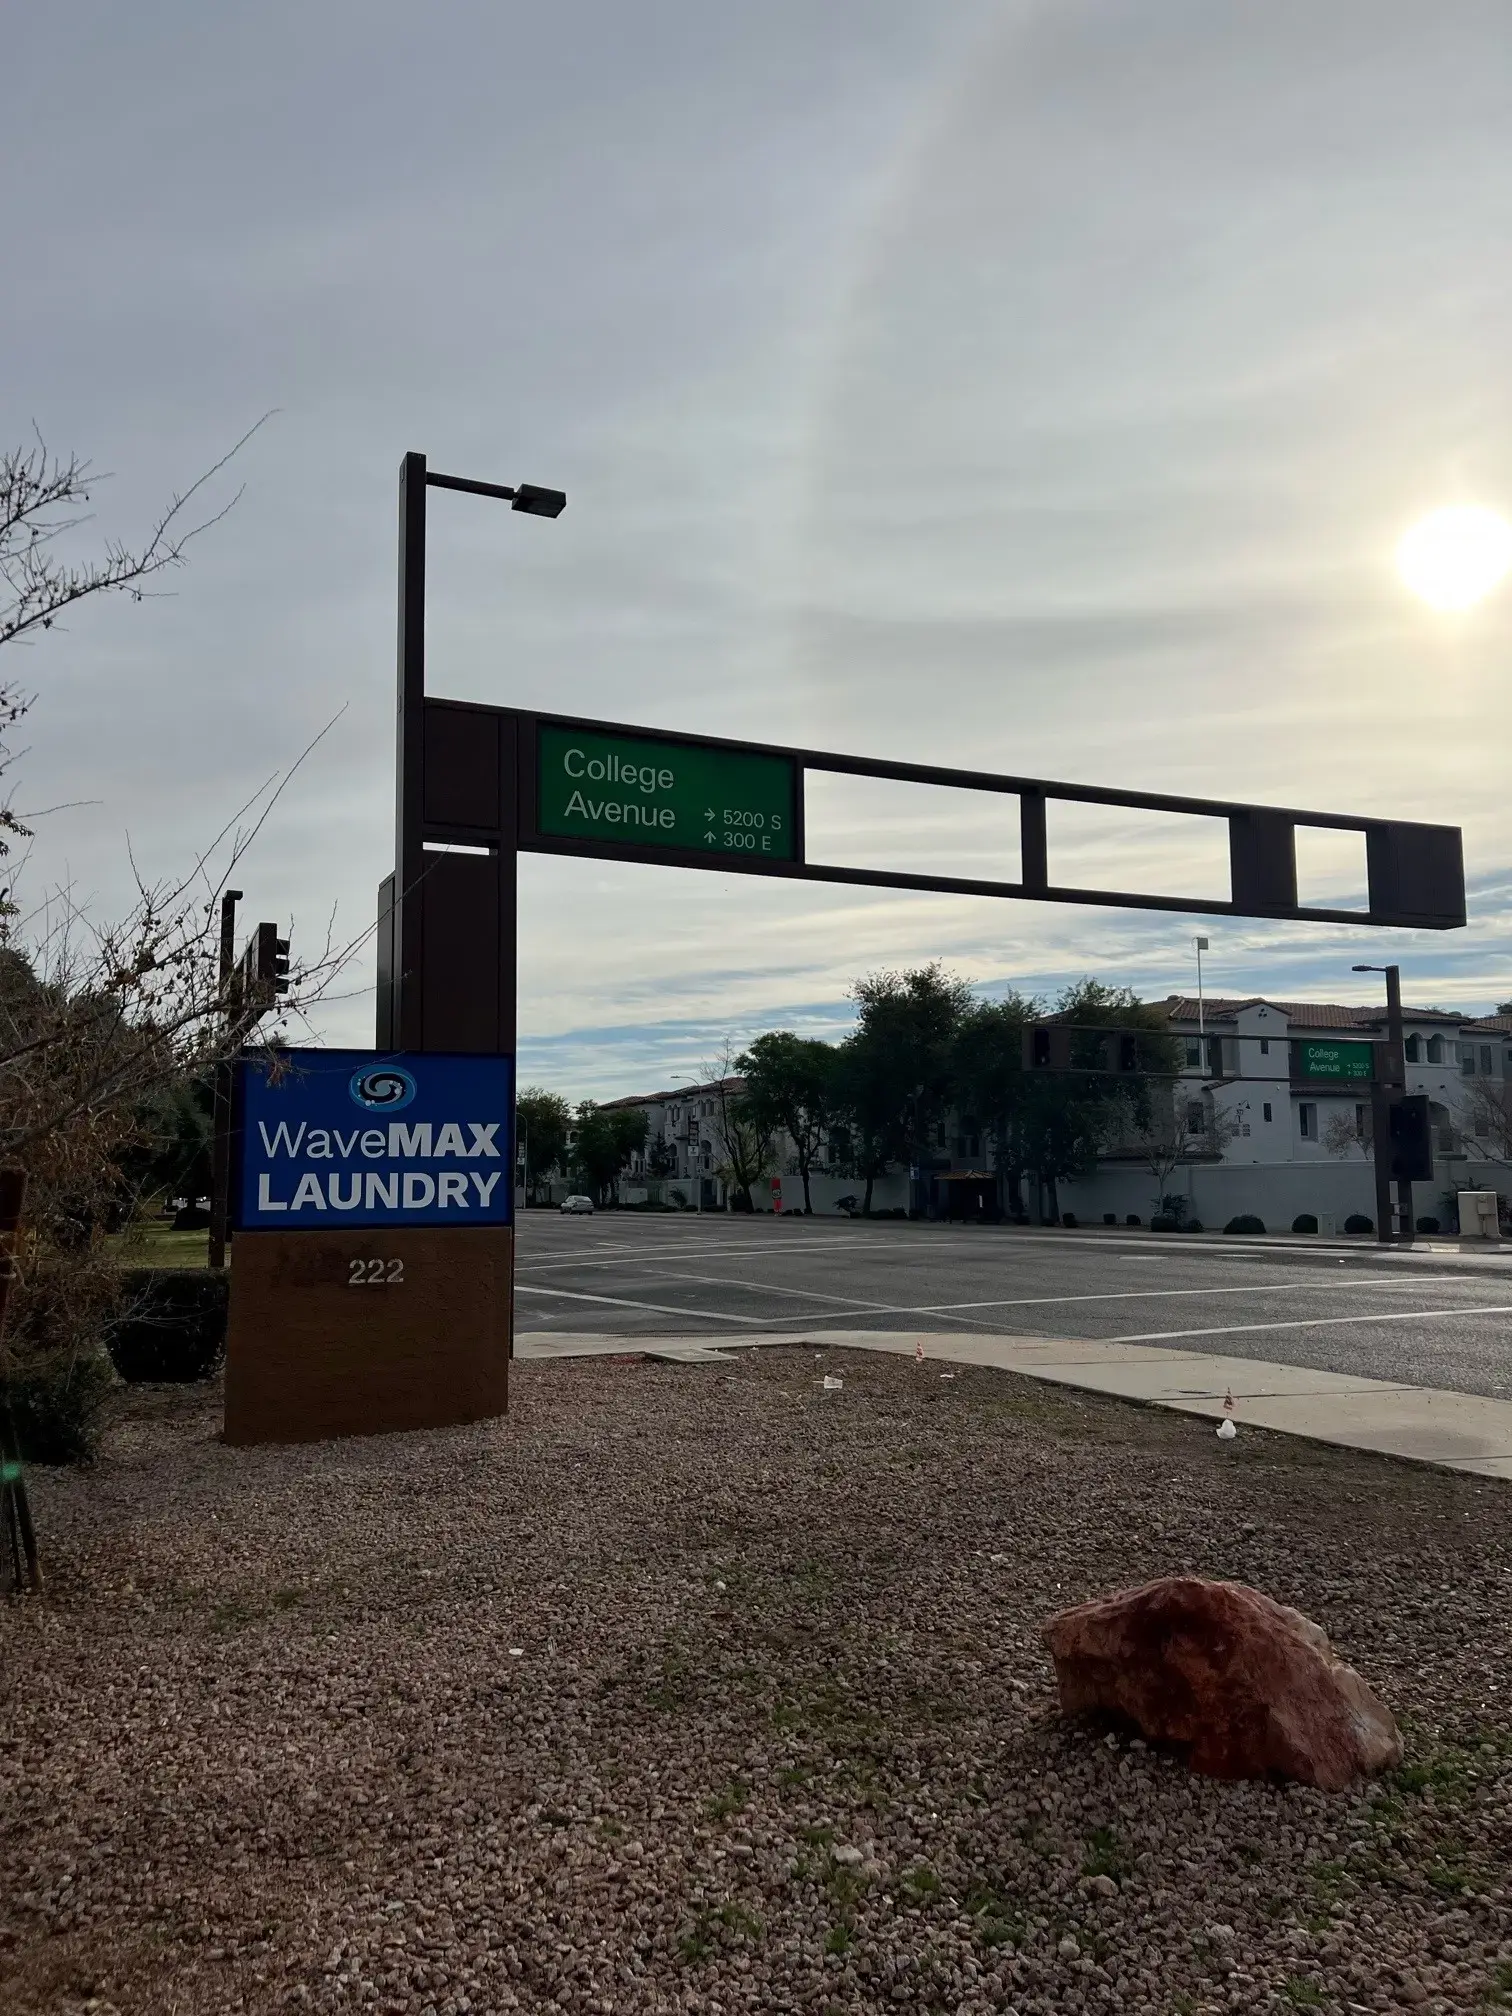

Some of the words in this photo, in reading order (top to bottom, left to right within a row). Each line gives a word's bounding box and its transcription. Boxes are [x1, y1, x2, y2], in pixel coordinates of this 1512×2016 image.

[564, 748, 674, 793] College
[564, 790, 676, 828] Avenue
[723, 809, 765, 828] 5200
[771, 815, 782, 830] S
[723, 831, 756, 849] 300
[762, 835, 772, 851] E
[1308, 1047, 1339, 1061] College
[1309, 1061, 1340, 1072] Avenue
[257, 1121, 501, 1158] WaveMAX
[258, 1171, 502, 1211] LAUNDRY
[348, 1258, 405, 1285] 222
